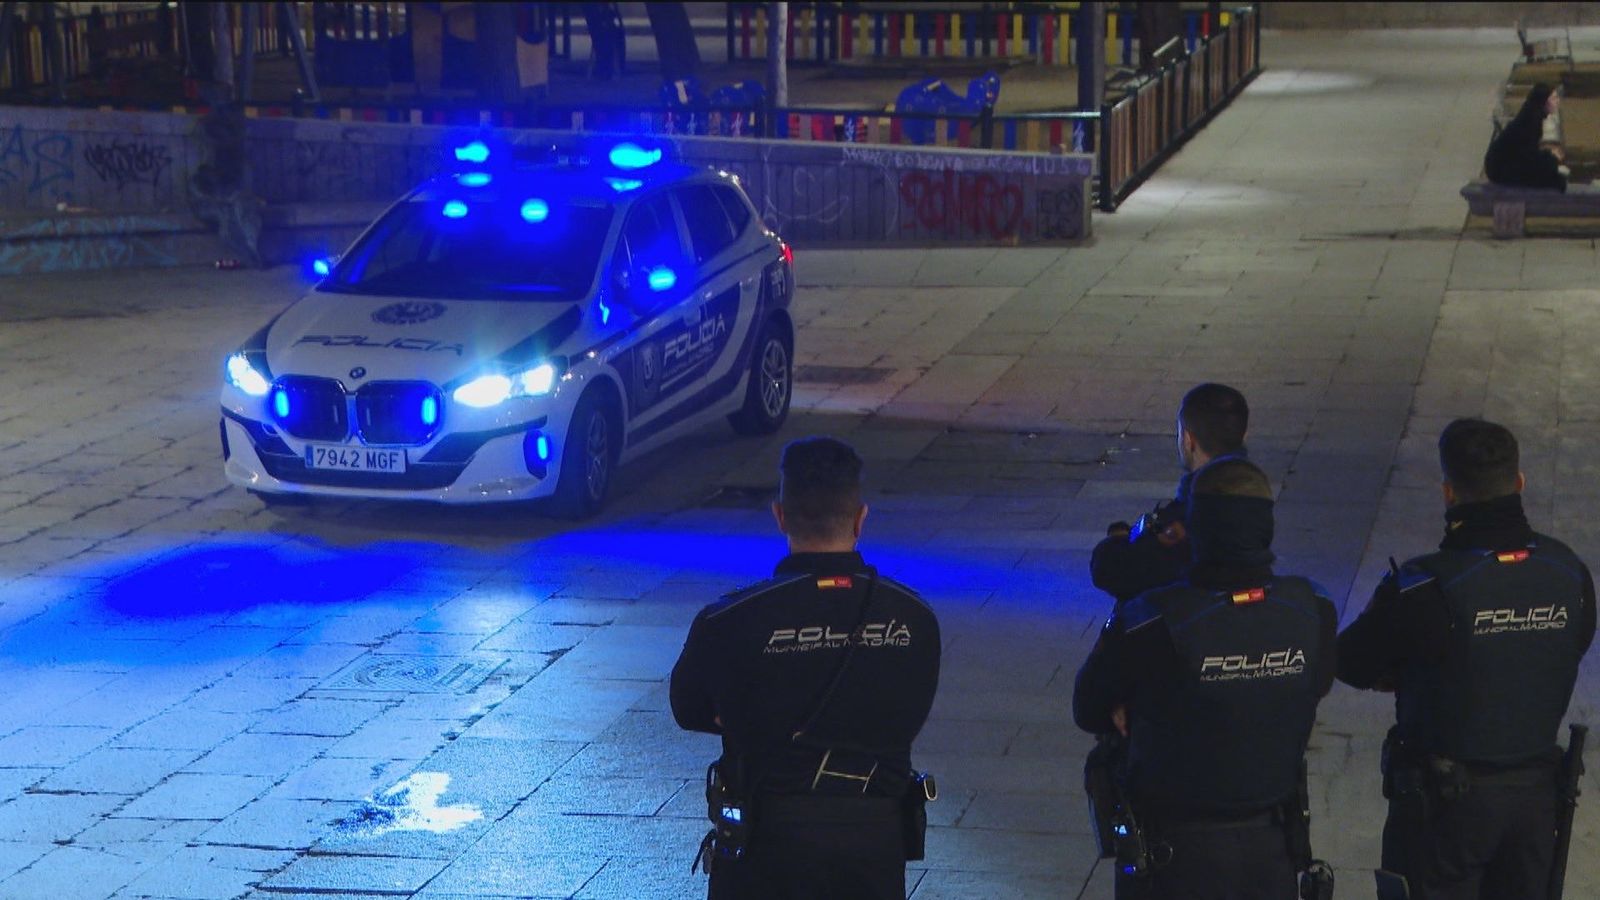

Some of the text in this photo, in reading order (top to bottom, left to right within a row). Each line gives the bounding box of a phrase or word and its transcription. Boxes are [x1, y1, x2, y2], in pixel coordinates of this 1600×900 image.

[316, 448, 399, 470] 7942 MGF
[768, 618, 911, 645] POLCÍA
